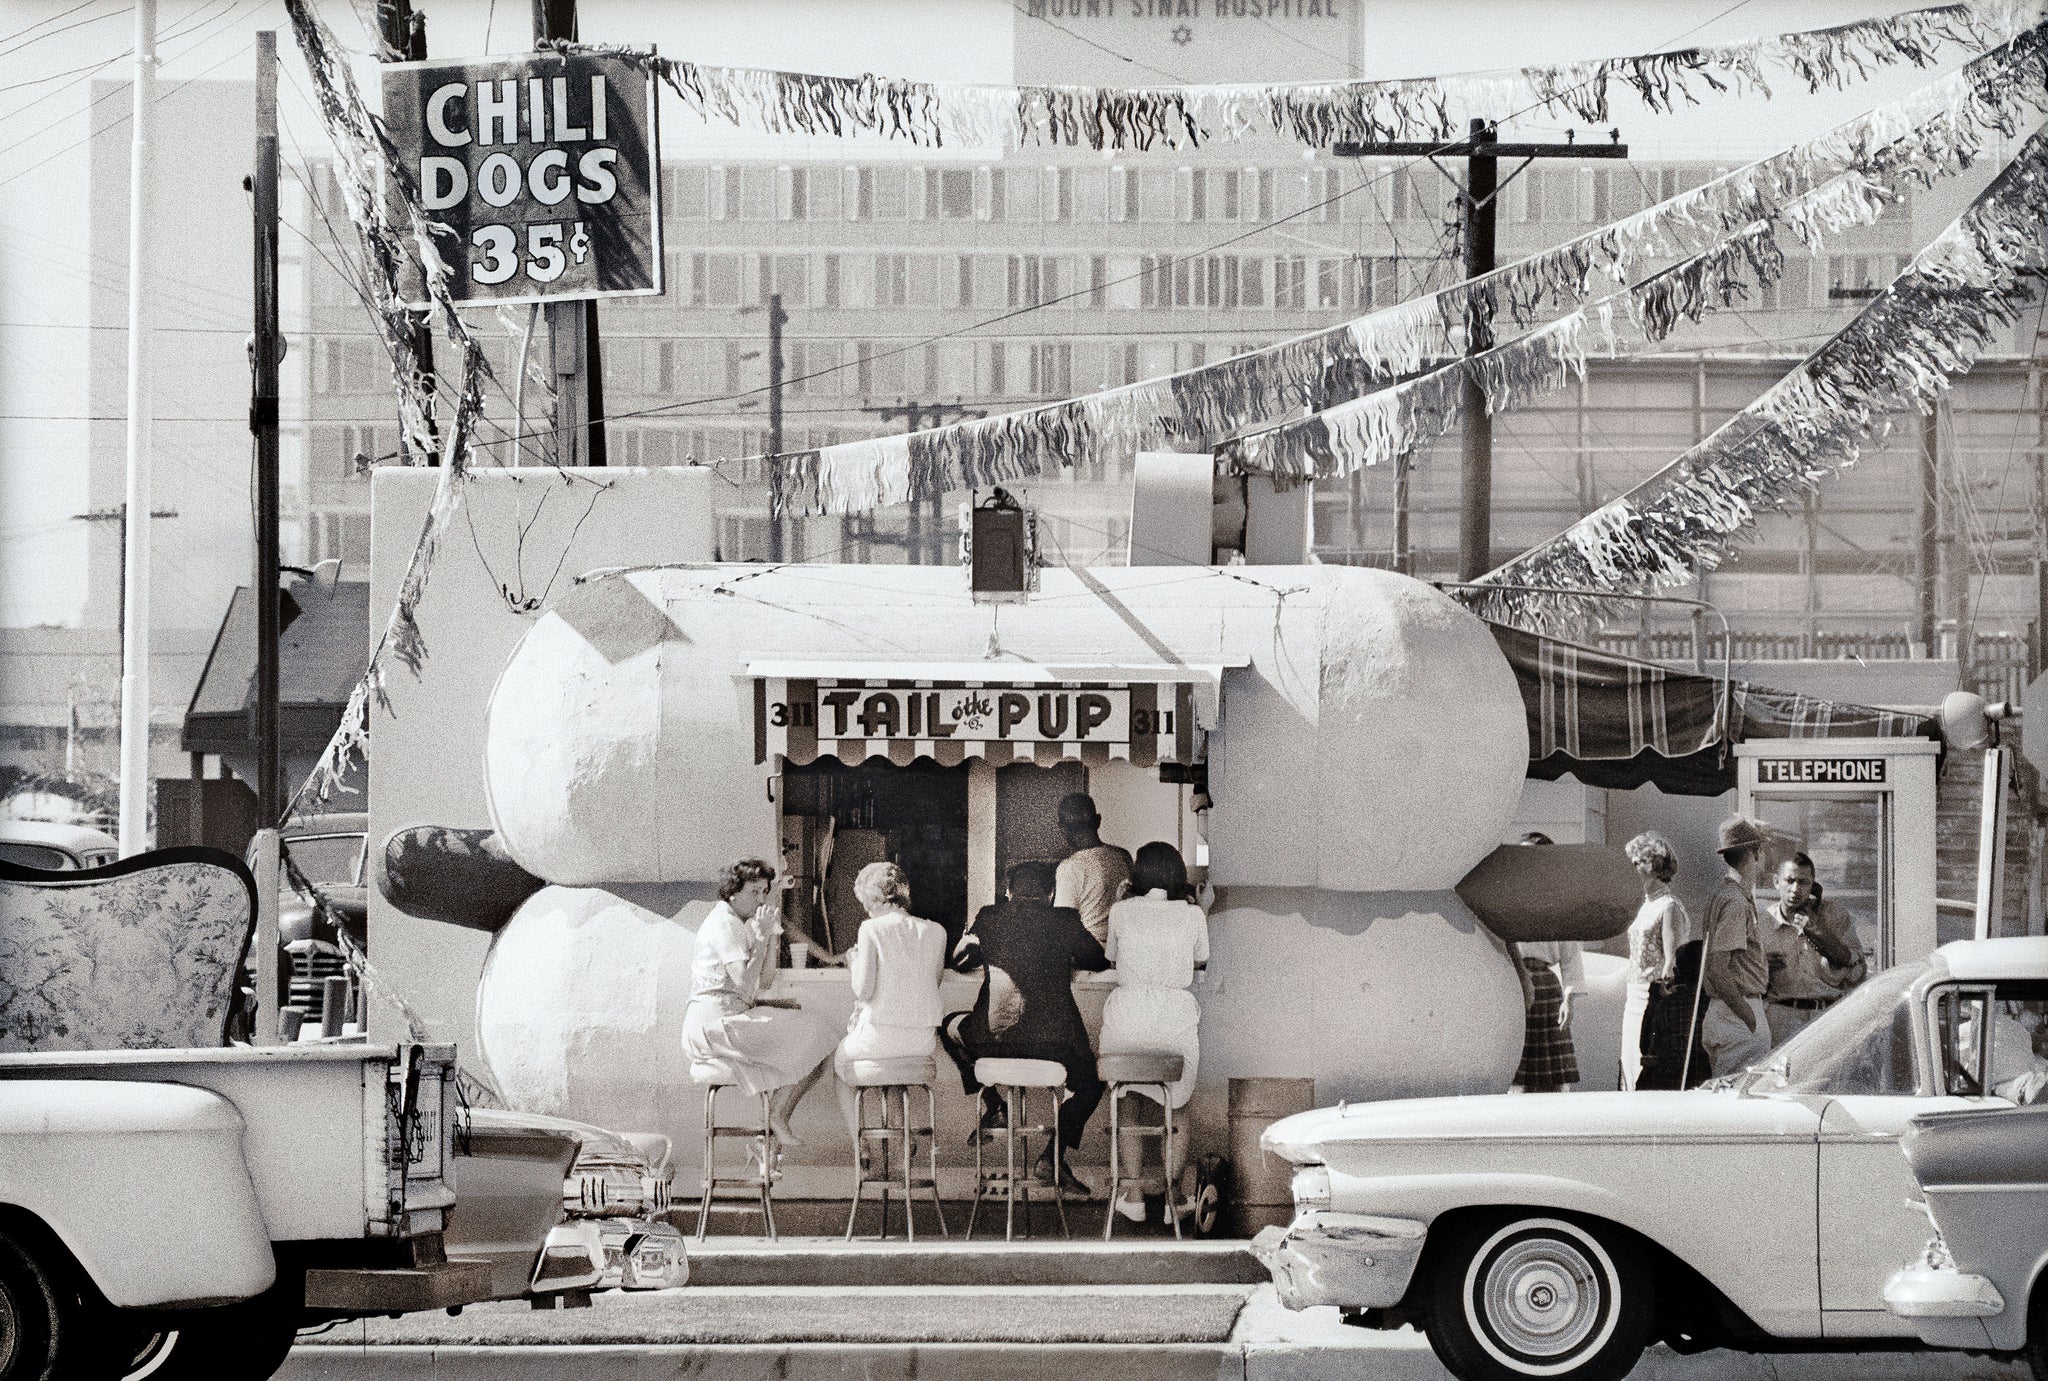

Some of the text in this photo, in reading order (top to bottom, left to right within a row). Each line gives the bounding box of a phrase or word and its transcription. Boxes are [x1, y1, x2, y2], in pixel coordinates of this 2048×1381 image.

[1029, 0, 1339, 18] MOUNT SINAI HOSPITAL
[425, 74, 607, 148] CHILI
[419, 147, 619, 211] DOGS
[471, 221, 591, 285] 35¢
[770, 702, 813, 728] 311
[821, 691, 959, 738] TAIL
[998, 692, 1113, 740] PUP
[1133, 709, 1175, 735] 311
[1762, 760, 1883, 781] TELEPHONE
